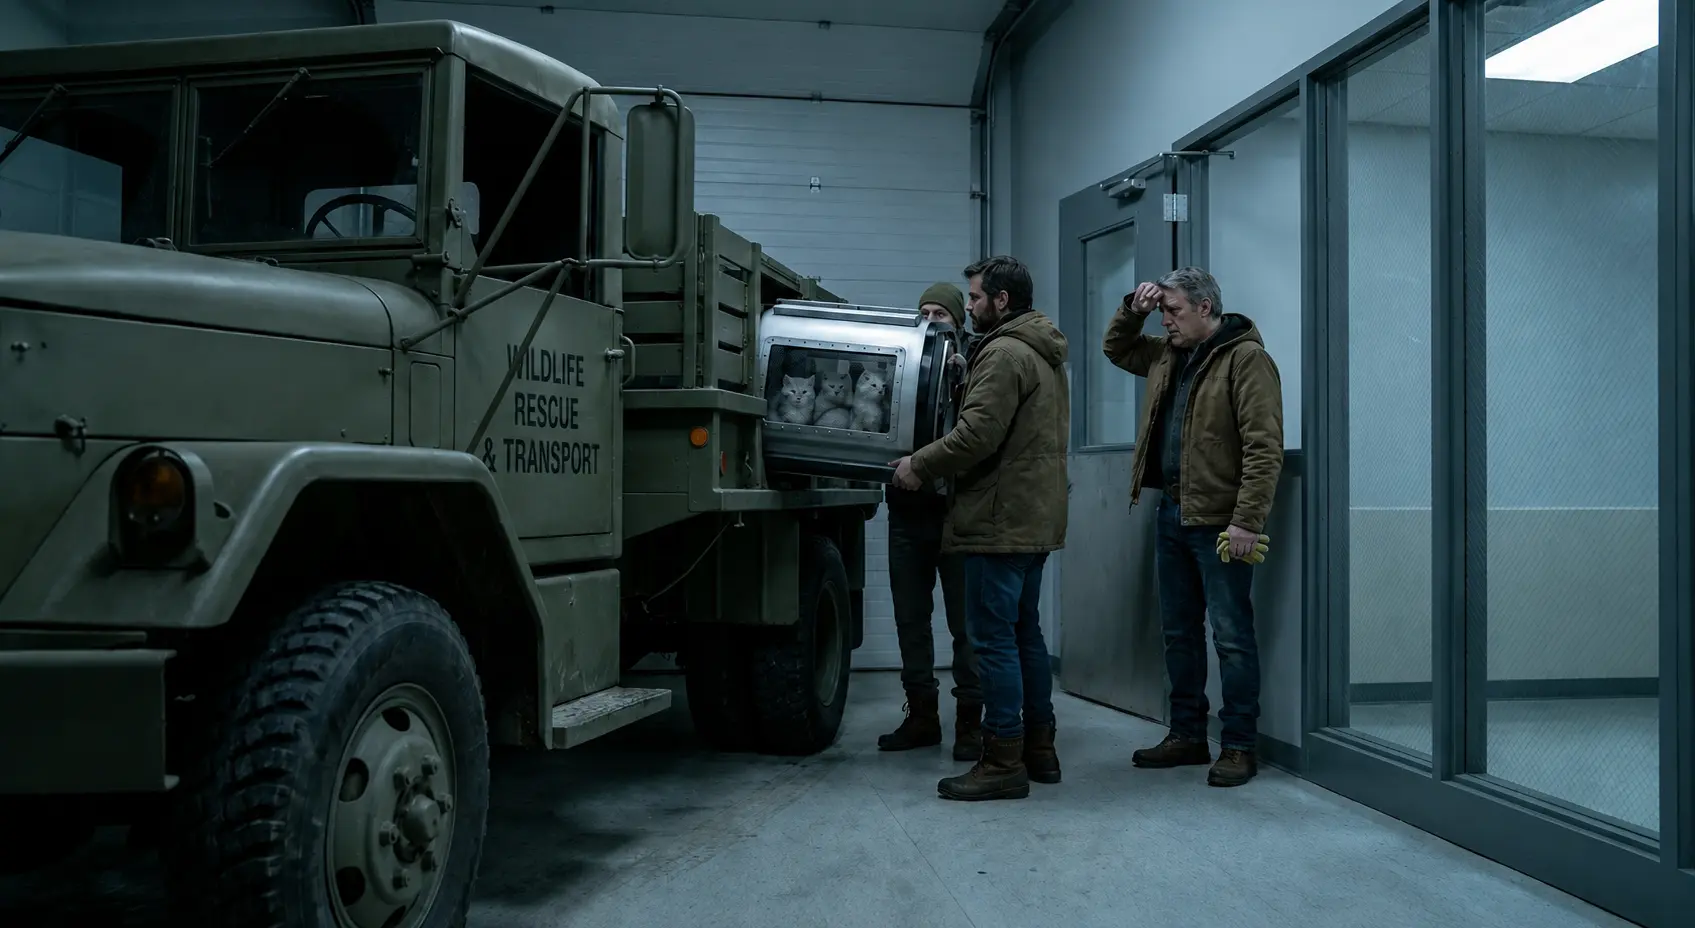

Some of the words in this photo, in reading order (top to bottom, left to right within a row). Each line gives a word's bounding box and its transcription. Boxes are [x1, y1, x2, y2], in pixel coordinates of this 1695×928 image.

[507, 343, 584, 387] WILDLIFE
[514, 392, 579, 429] RESCUE
[482, 437, 497, 473] &
[503, 438, 600, 474] TRANSPORT
